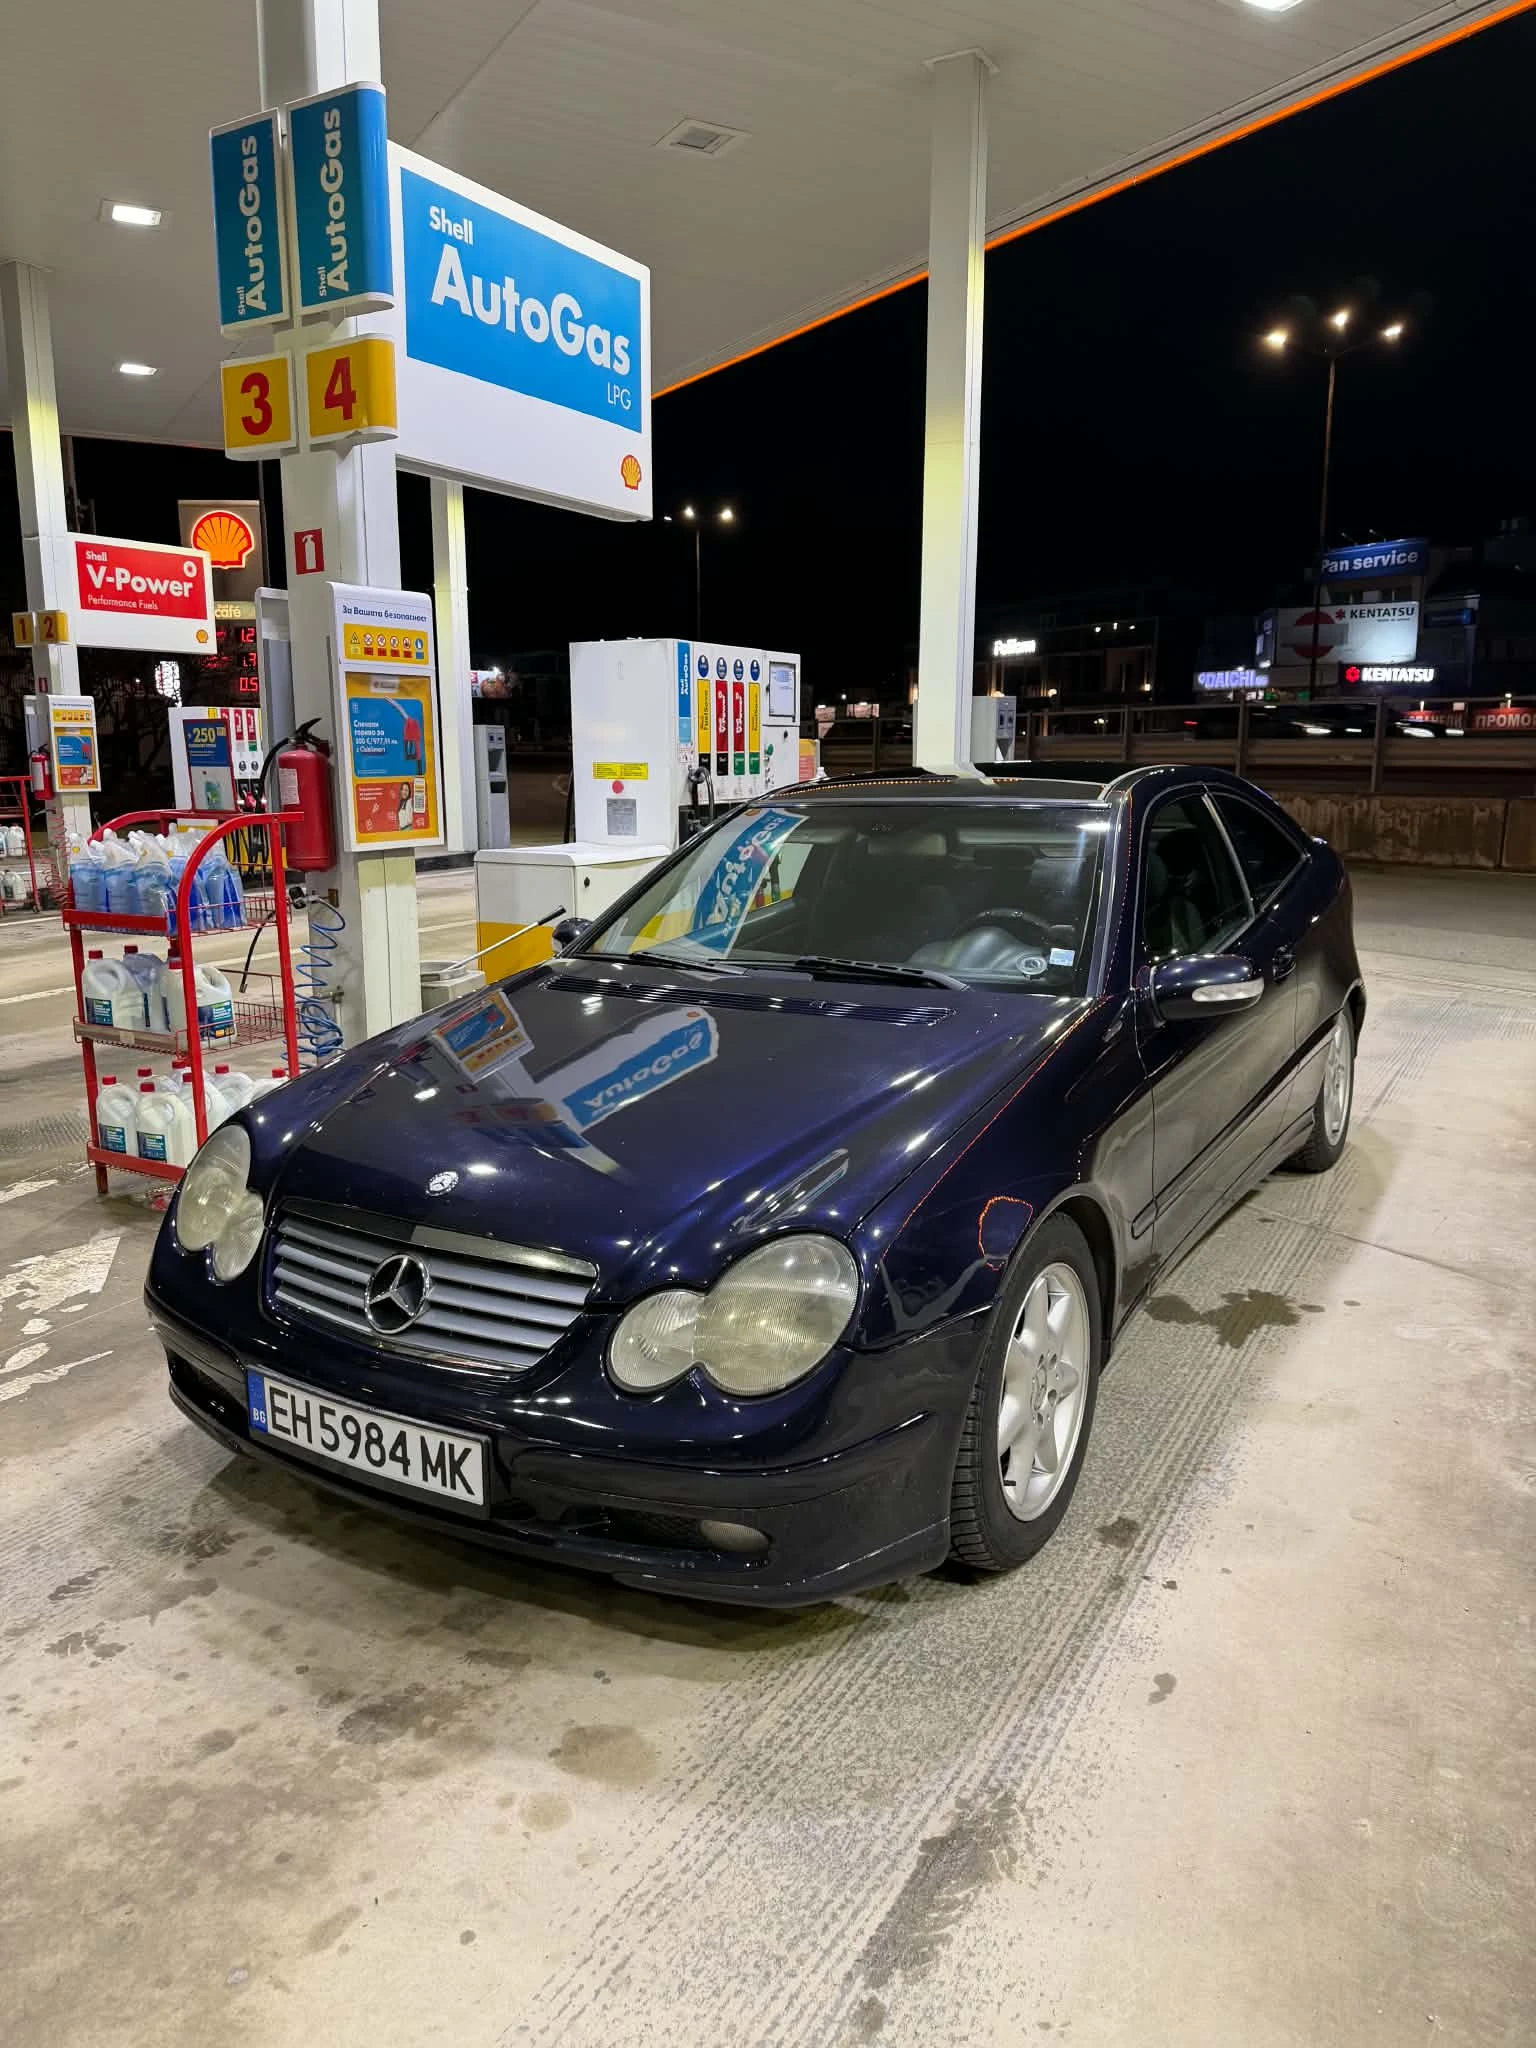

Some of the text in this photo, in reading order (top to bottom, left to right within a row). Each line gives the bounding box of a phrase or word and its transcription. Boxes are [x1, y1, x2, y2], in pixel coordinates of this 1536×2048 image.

[320, 107, 350, 293] AutoGas
[238, 135, 267, 312] AutoGas
[429, 205, 474, 246] Shell
[319, 266, 327, 297] Shell
[237, 286, 246, 316] Shell
[431, 243, 631, 376] AutoGas
[324, 356, 357, 421] 4
[607, 382, 632, 411] LPG
[240, 372, 273, 436] 3
[86, 550, 108, 562] Shell
[1352, 550, 1418, 570] service
[86, 564, 193, 598] V-Power
[87, 594, 159, 610] Performance Fuels
[342, 605, 352, 614] За
[1350, 607, 1415, 619] KENTATSU
[18, 618, 27, 634] 1
[43, 616, 55, 633] 2
[1361, 667, 1434, 682] KENTATSU
[192, 727, 215, 743] 250
[253, 1407, 266, 1424] BG
[269, 1385, 475, 1496] EH 5984 MK
